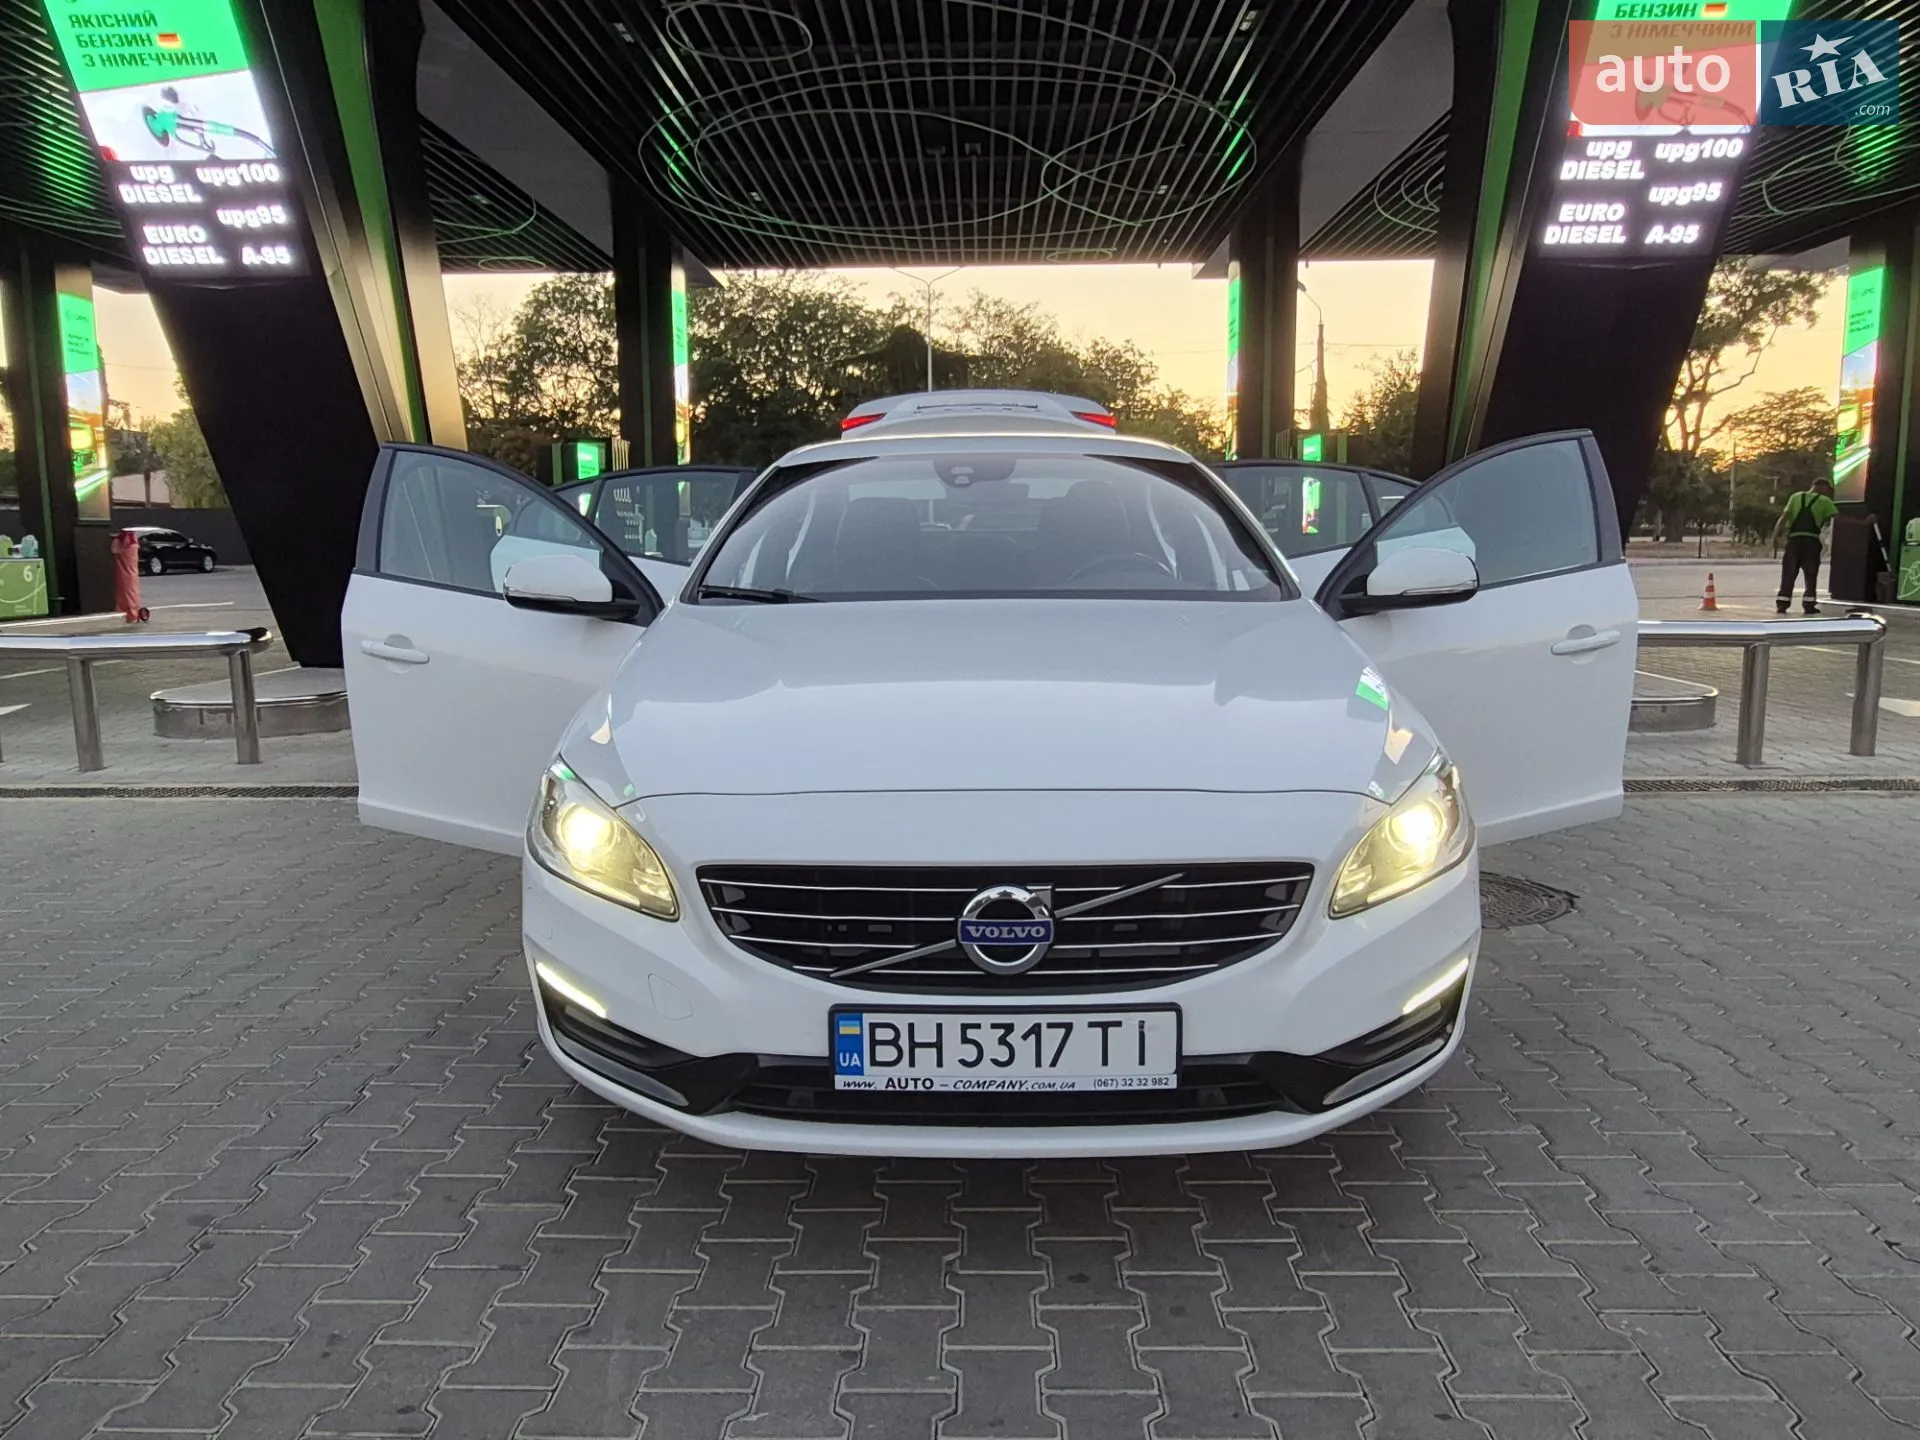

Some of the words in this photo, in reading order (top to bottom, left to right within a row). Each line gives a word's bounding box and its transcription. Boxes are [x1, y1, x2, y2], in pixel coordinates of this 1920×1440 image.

[68, 10, 158, 28] ЯКІСНИЙ
[1615, 3, 1697, 18] БЕНЗИН
[75, 33, 154, 48] БЕНЗИН
[99, 52, 219, 67] НІМЕЧЧИНИ
[1586, 141, 1632, 158] upg
[1654, 139, 1744, 162] upg100
[129, 166, 174, 183] upg
[196, 163, 280, 186] upg100
[1560, 161, 1645, 180] DIESEL
[118, 184, 203, 203] DIESEL
[1648, 183, 1722, 205] upg95
[216, 206, 287, 228] upg95
[1558, 203, 1625, 223] EURO
[143, 225, 206, 244] EURO
[1544, 225, 1627, 244] DIESEL
[1645, 225, 1701, 244] A-95
[142, 247, 225, 265] DIESEL
[23, 564, 33, 583] 6
[965, 926, 1046, 938] VOLVO
[868, 1021, 944, 1068] BH
[957, 1021, 1074, 1068] 5317
[839, 1053, 862, 1067] UA
[884, 1077, 934, 1090] AUTO
[1093, 1079, 1119, 1088] (067)
[1121, 1078, 1133, 1087] 32
[1136, 1078, 1149, 1087] 32
[1151, 1077, 1170, 1086] 982
